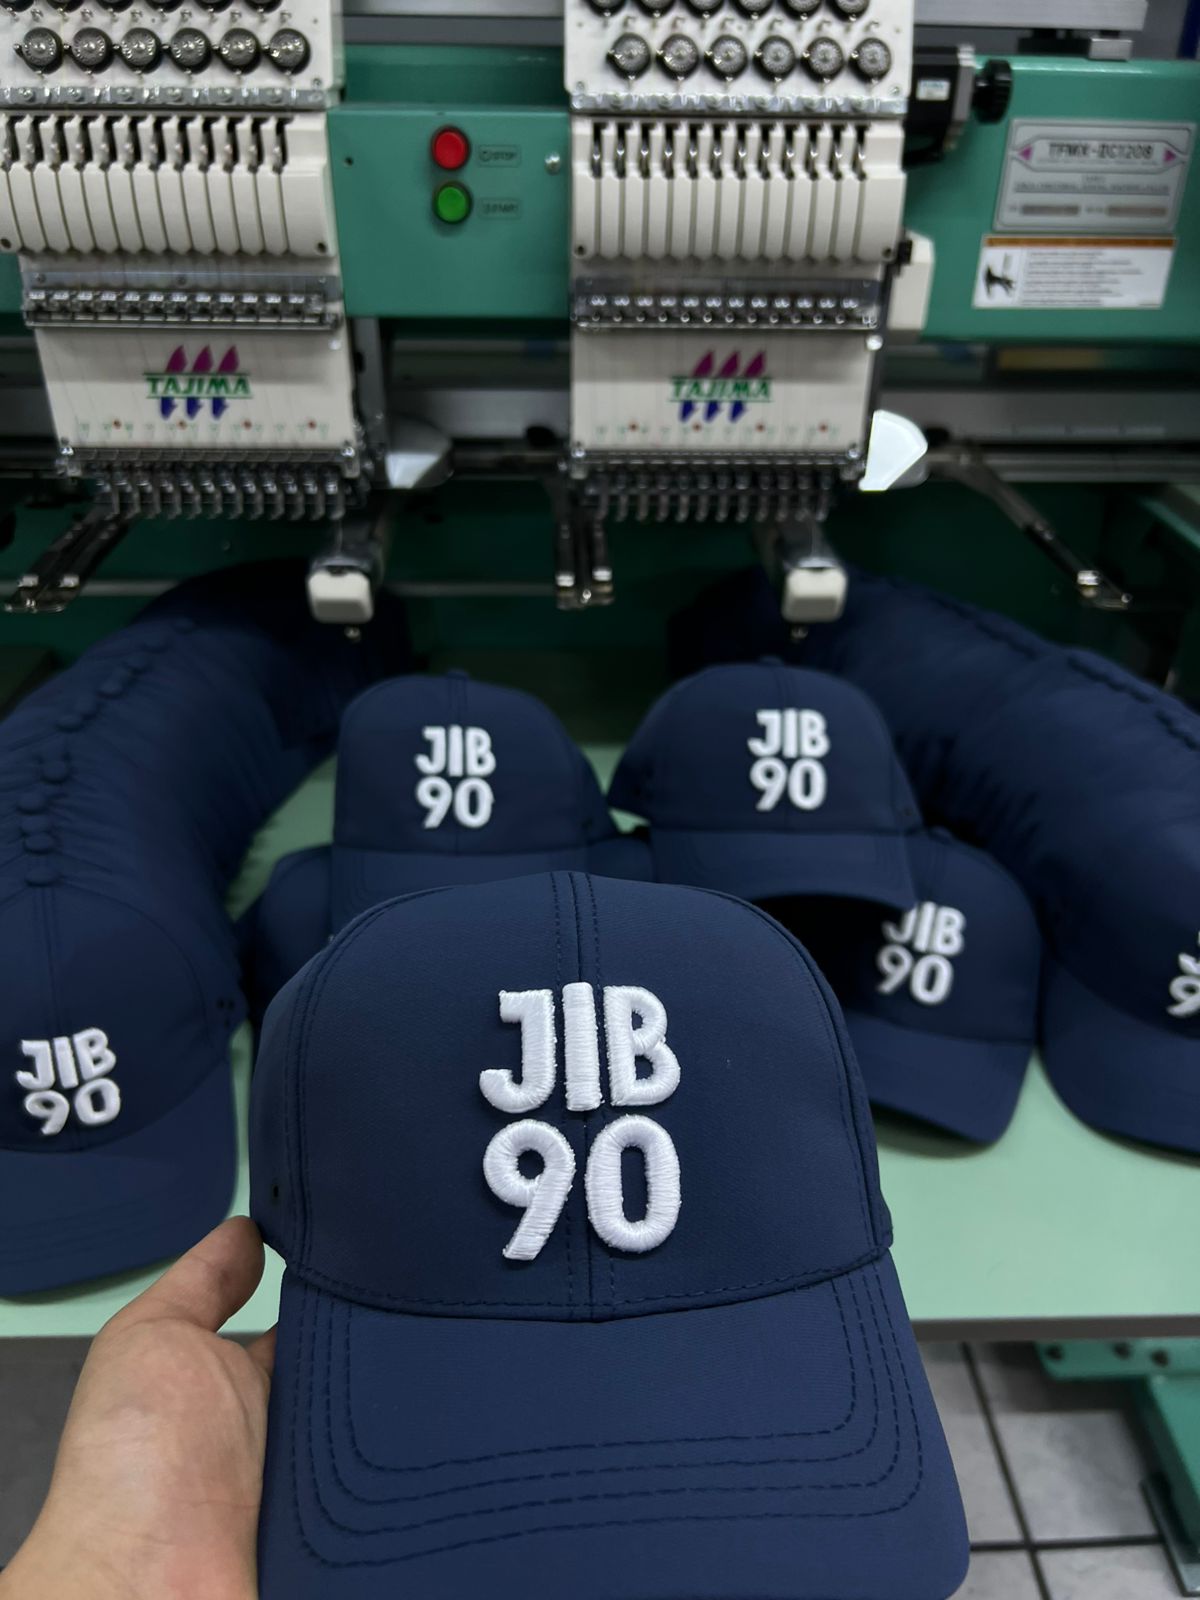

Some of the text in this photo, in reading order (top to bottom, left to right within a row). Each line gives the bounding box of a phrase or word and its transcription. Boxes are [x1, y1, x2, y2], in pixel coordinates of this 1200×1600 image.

[145, 377, 251, 394] TAJIMA
[673, 379, 771, 398] TAJIMA
[415, 725, 496, 777] JIB
[747, 708, 831, 758] JIB
[416, 777, 495, 829] 90
[749, 757, 827, 811] 90
[882, 900, 966, 956] JIB
[877, 944, 954, 1004] 90
[1166, 975, 1200, 1018] 9
[16, 1027, 117, 1089] JIB
[479, 981, 682, 1114] JIB
[24, 1077, 121, 1135] 90
[482, 1113, 683, 1261] 90
